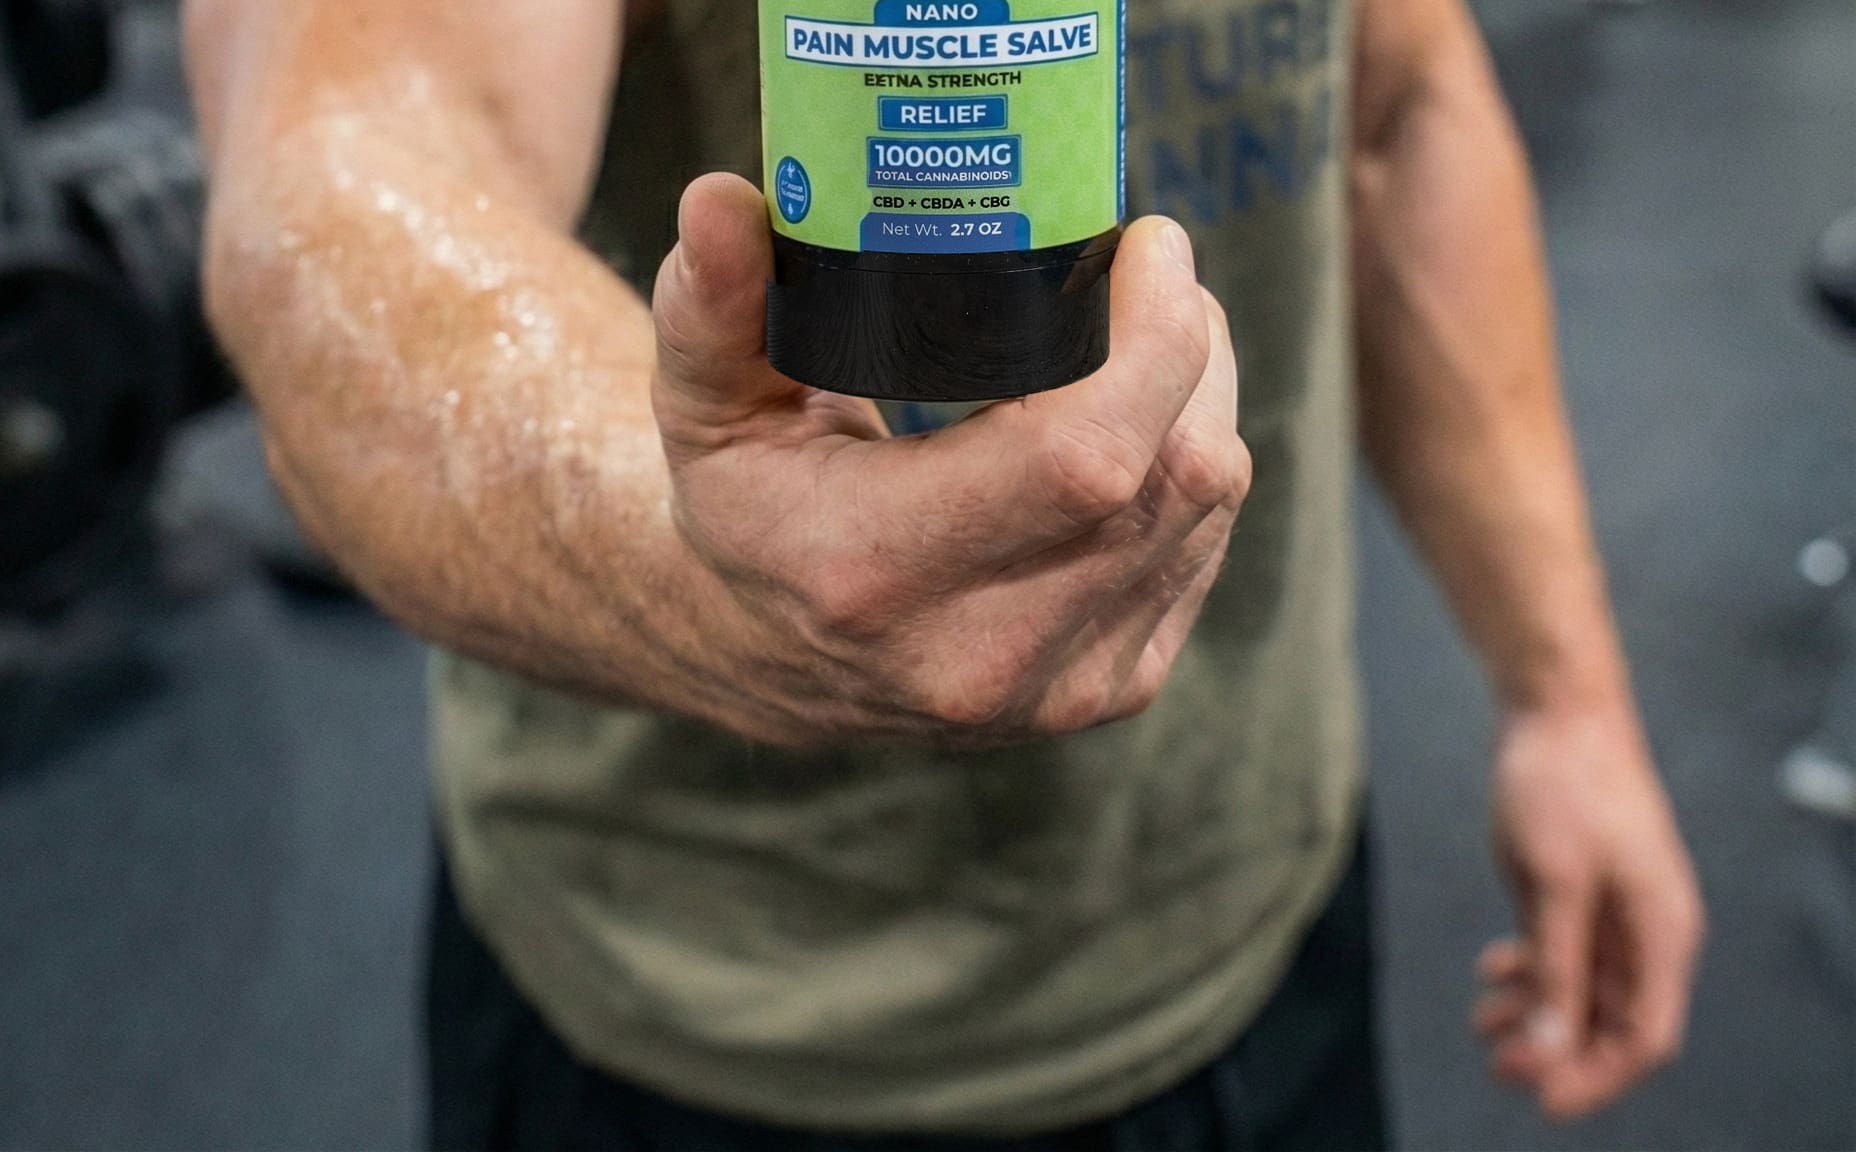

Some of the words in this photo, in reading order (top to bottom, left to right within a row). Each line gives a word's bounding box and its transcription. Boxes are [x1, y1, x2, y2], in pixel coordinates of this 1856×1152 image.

[906, 3, 979, 21] NANO
[793, 28, 854, 57] PAIN
[864, 33, 998, 60] MUSCLE
[1008, 23, 1092, 56] SALVE
[927, 71, 1022, 88] STRENGTH
[901, 104, 987, 124] RELIEF
[874, 144, 1012, 167] 10000MG
[875, 170, 913, 181] TOTAL
[915, 170, 1010, 182] CANNABINOIDS
[873, 196, 904, 208] CBD
[920, 197, 965, 209] CBDA
[980, 195, 1010, 208] CBG
[882, 222, 910, 236] Net
[914, 223, 942, 237] Wt.
[950, 223, 975, 236] 2.7
[978, 222, 1002, 236] OZ
